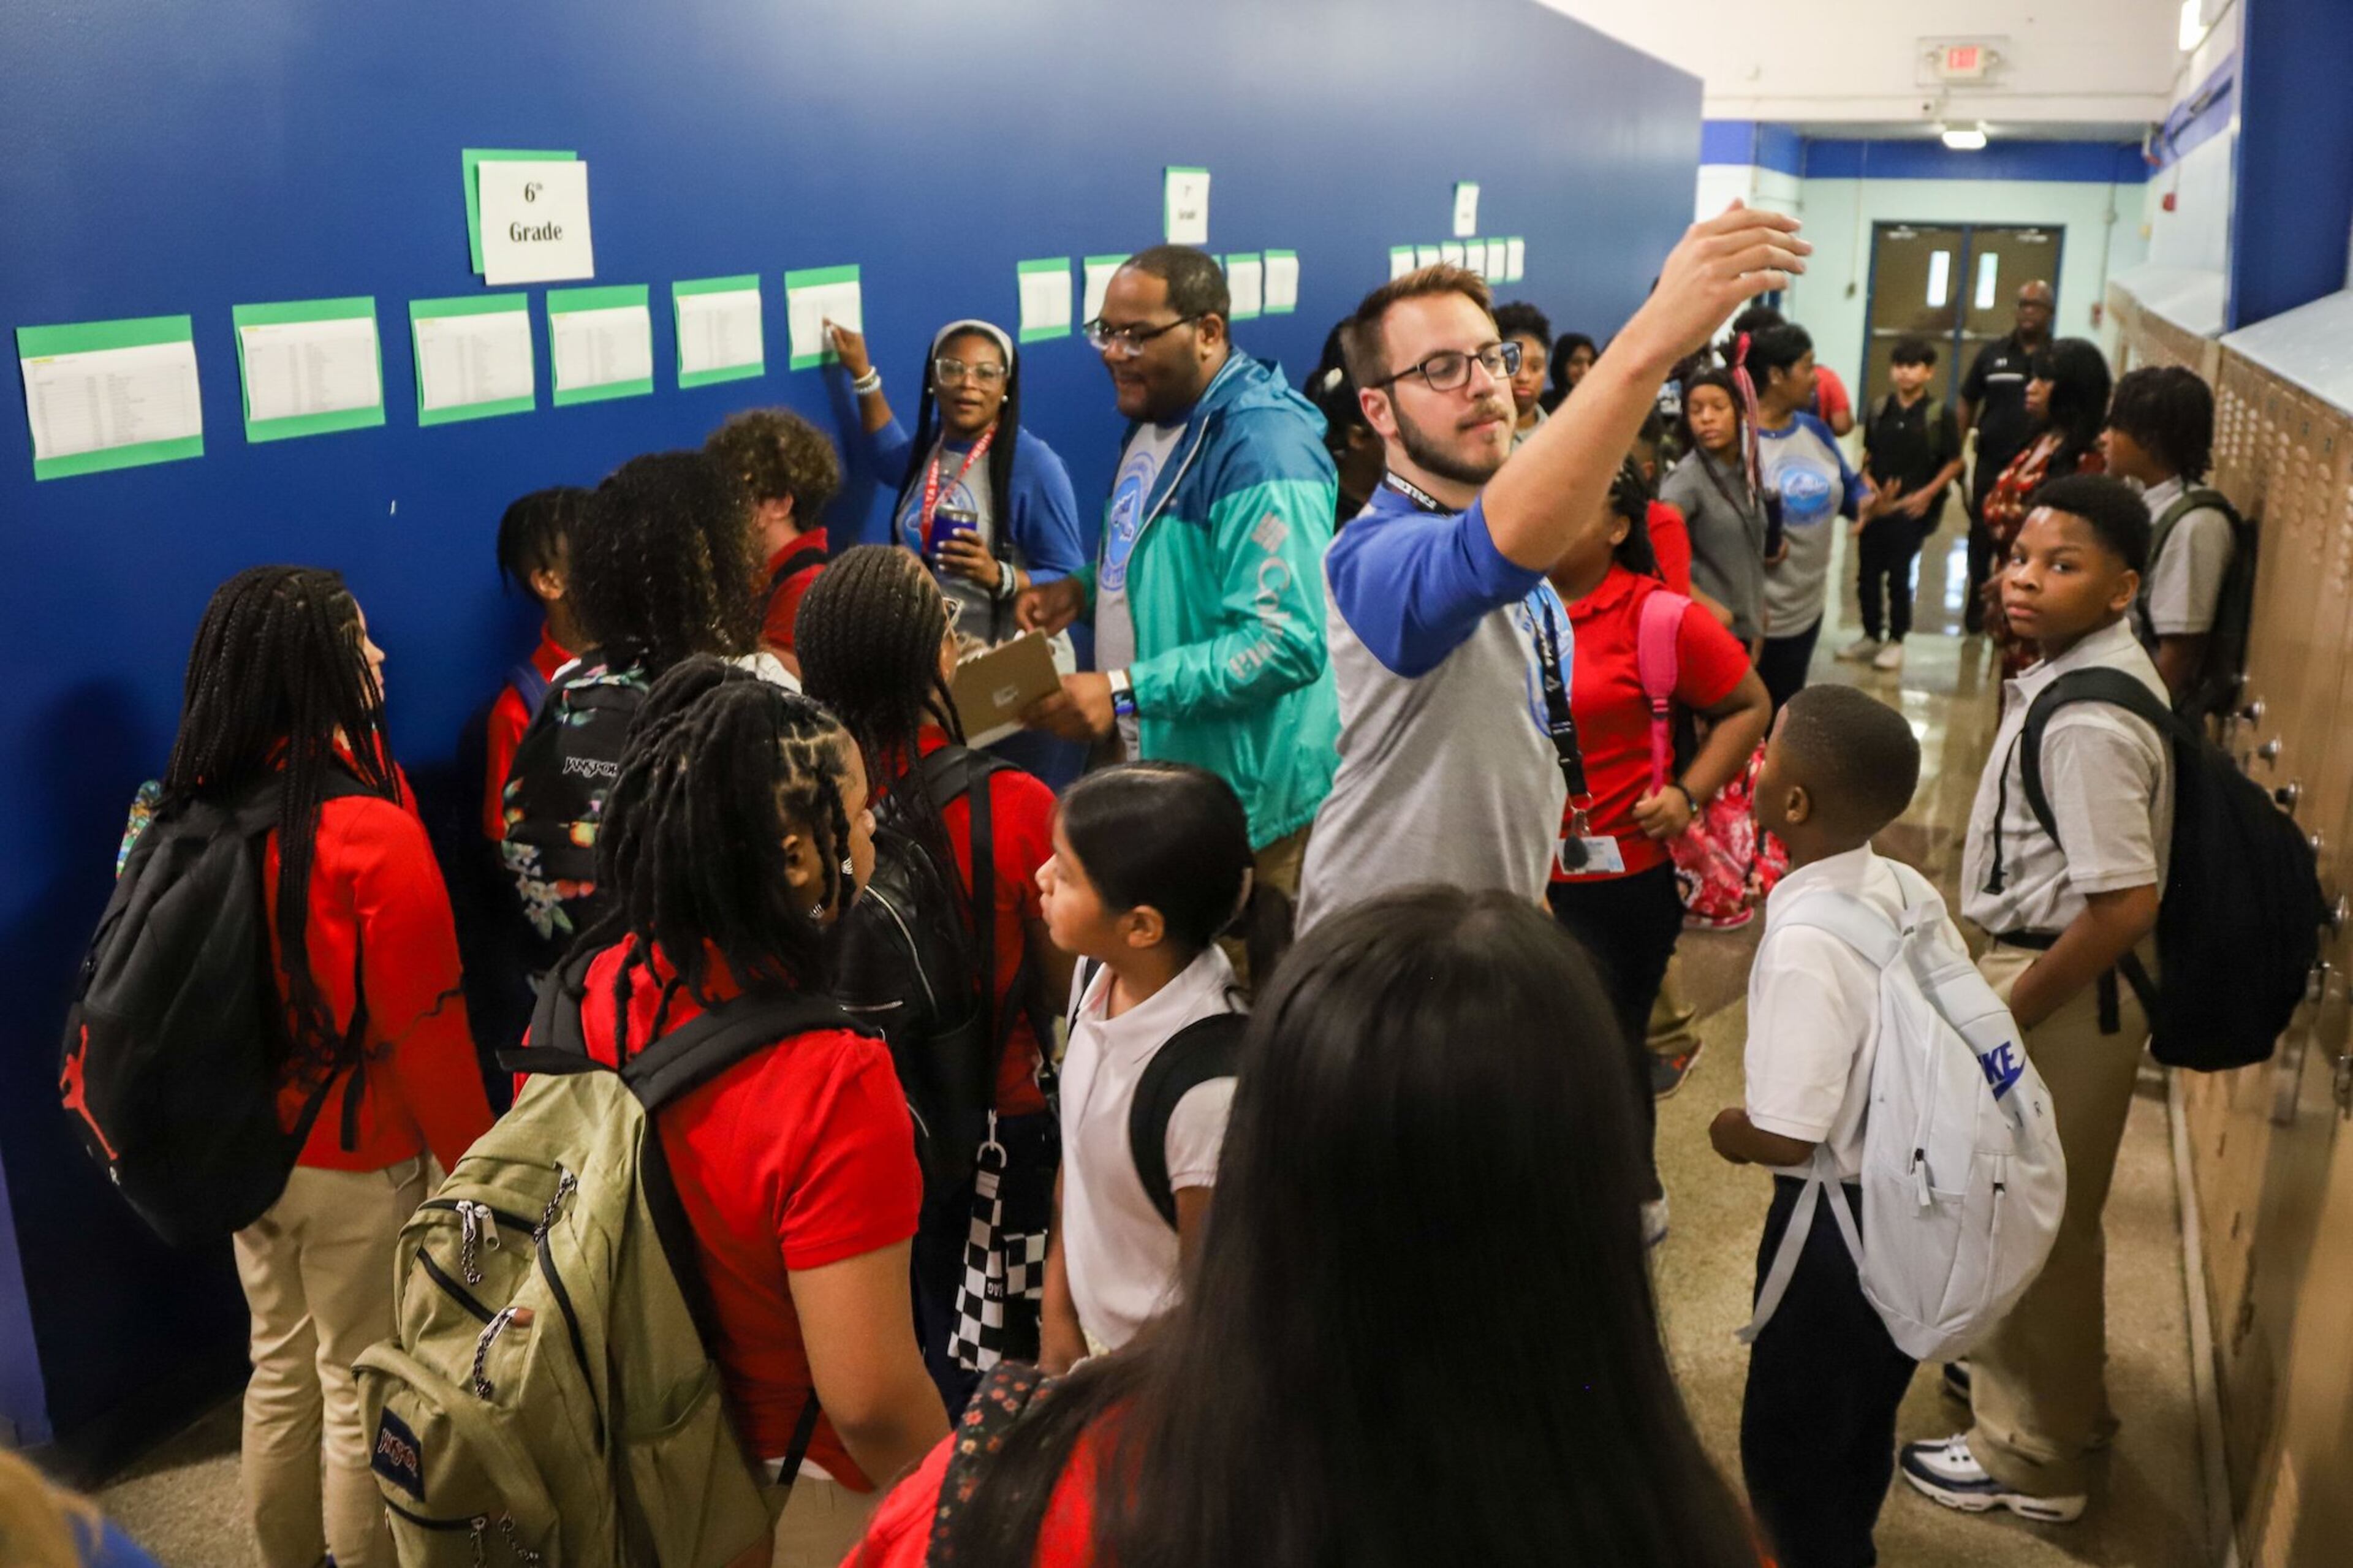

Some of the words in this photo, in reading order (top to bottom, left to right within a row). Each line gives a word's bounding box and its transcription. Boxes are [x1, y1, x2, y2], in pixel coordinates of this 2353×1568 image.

[509, 221, 563, 243] Grade
[562, 756, 618, 778] JANSPOR
[1977, 1040, 2016, 1085] KE
